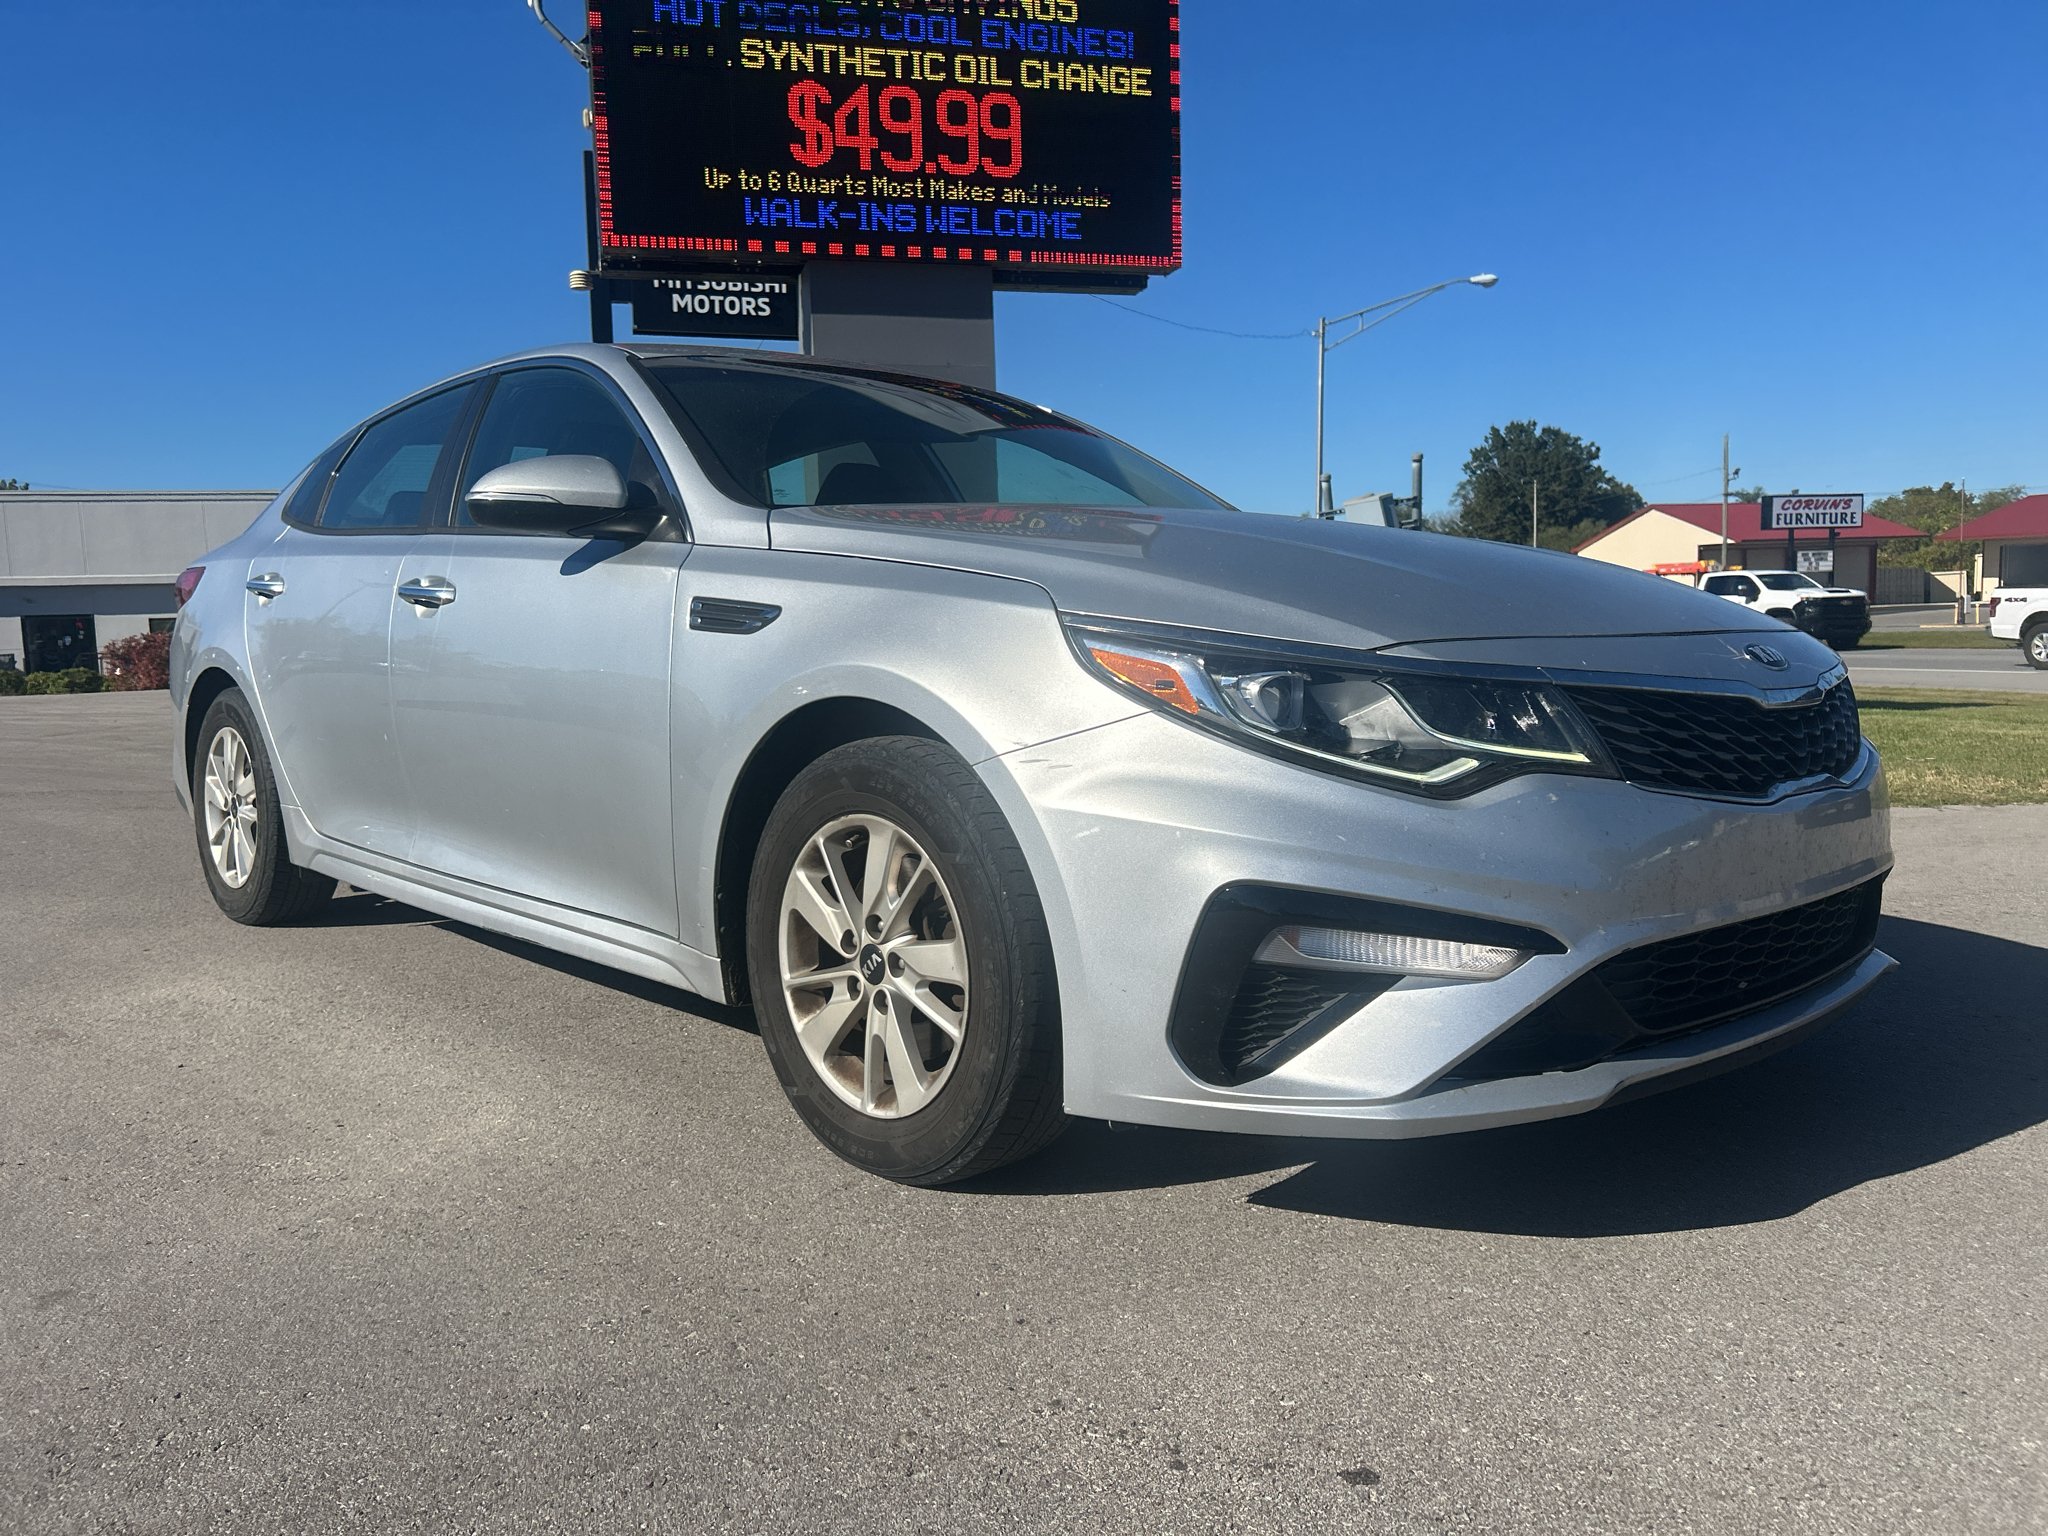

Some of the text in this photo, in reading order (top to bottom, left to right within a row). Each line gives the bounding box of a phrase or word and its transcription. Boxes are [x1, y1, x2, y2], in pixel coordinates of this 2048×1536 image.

[654, 0, 728, 27] HOT
[880, 12, 972, 47] COOL
[982, 19, 1133, 59] ENGINES!
[740, 39, 946, 82] SYNTHETIC
[954, 54, 1012, 86] OIL
[1020, 59, 1152, 96] CHANGE
[788, 79, 1022, 178] $49.99
[704, 167, 732, 189] Up
[738, 168, 762, 190] to
[768, 170, 781, 191] 6
[787, 170, 867, 196] Quarts
[872, 175, 925, 198] Most
[929, 177, 996, 201] Makes
[744, 197, 1082, 240] WALK-INS WELCOME
[672, 293, 771, 317] MOTORS
[1776, 511, 1857, 526] FURNITURE
[1781, 498, 1853, 511] CORVIN'S
[861, 952, 882, 978] KIA
